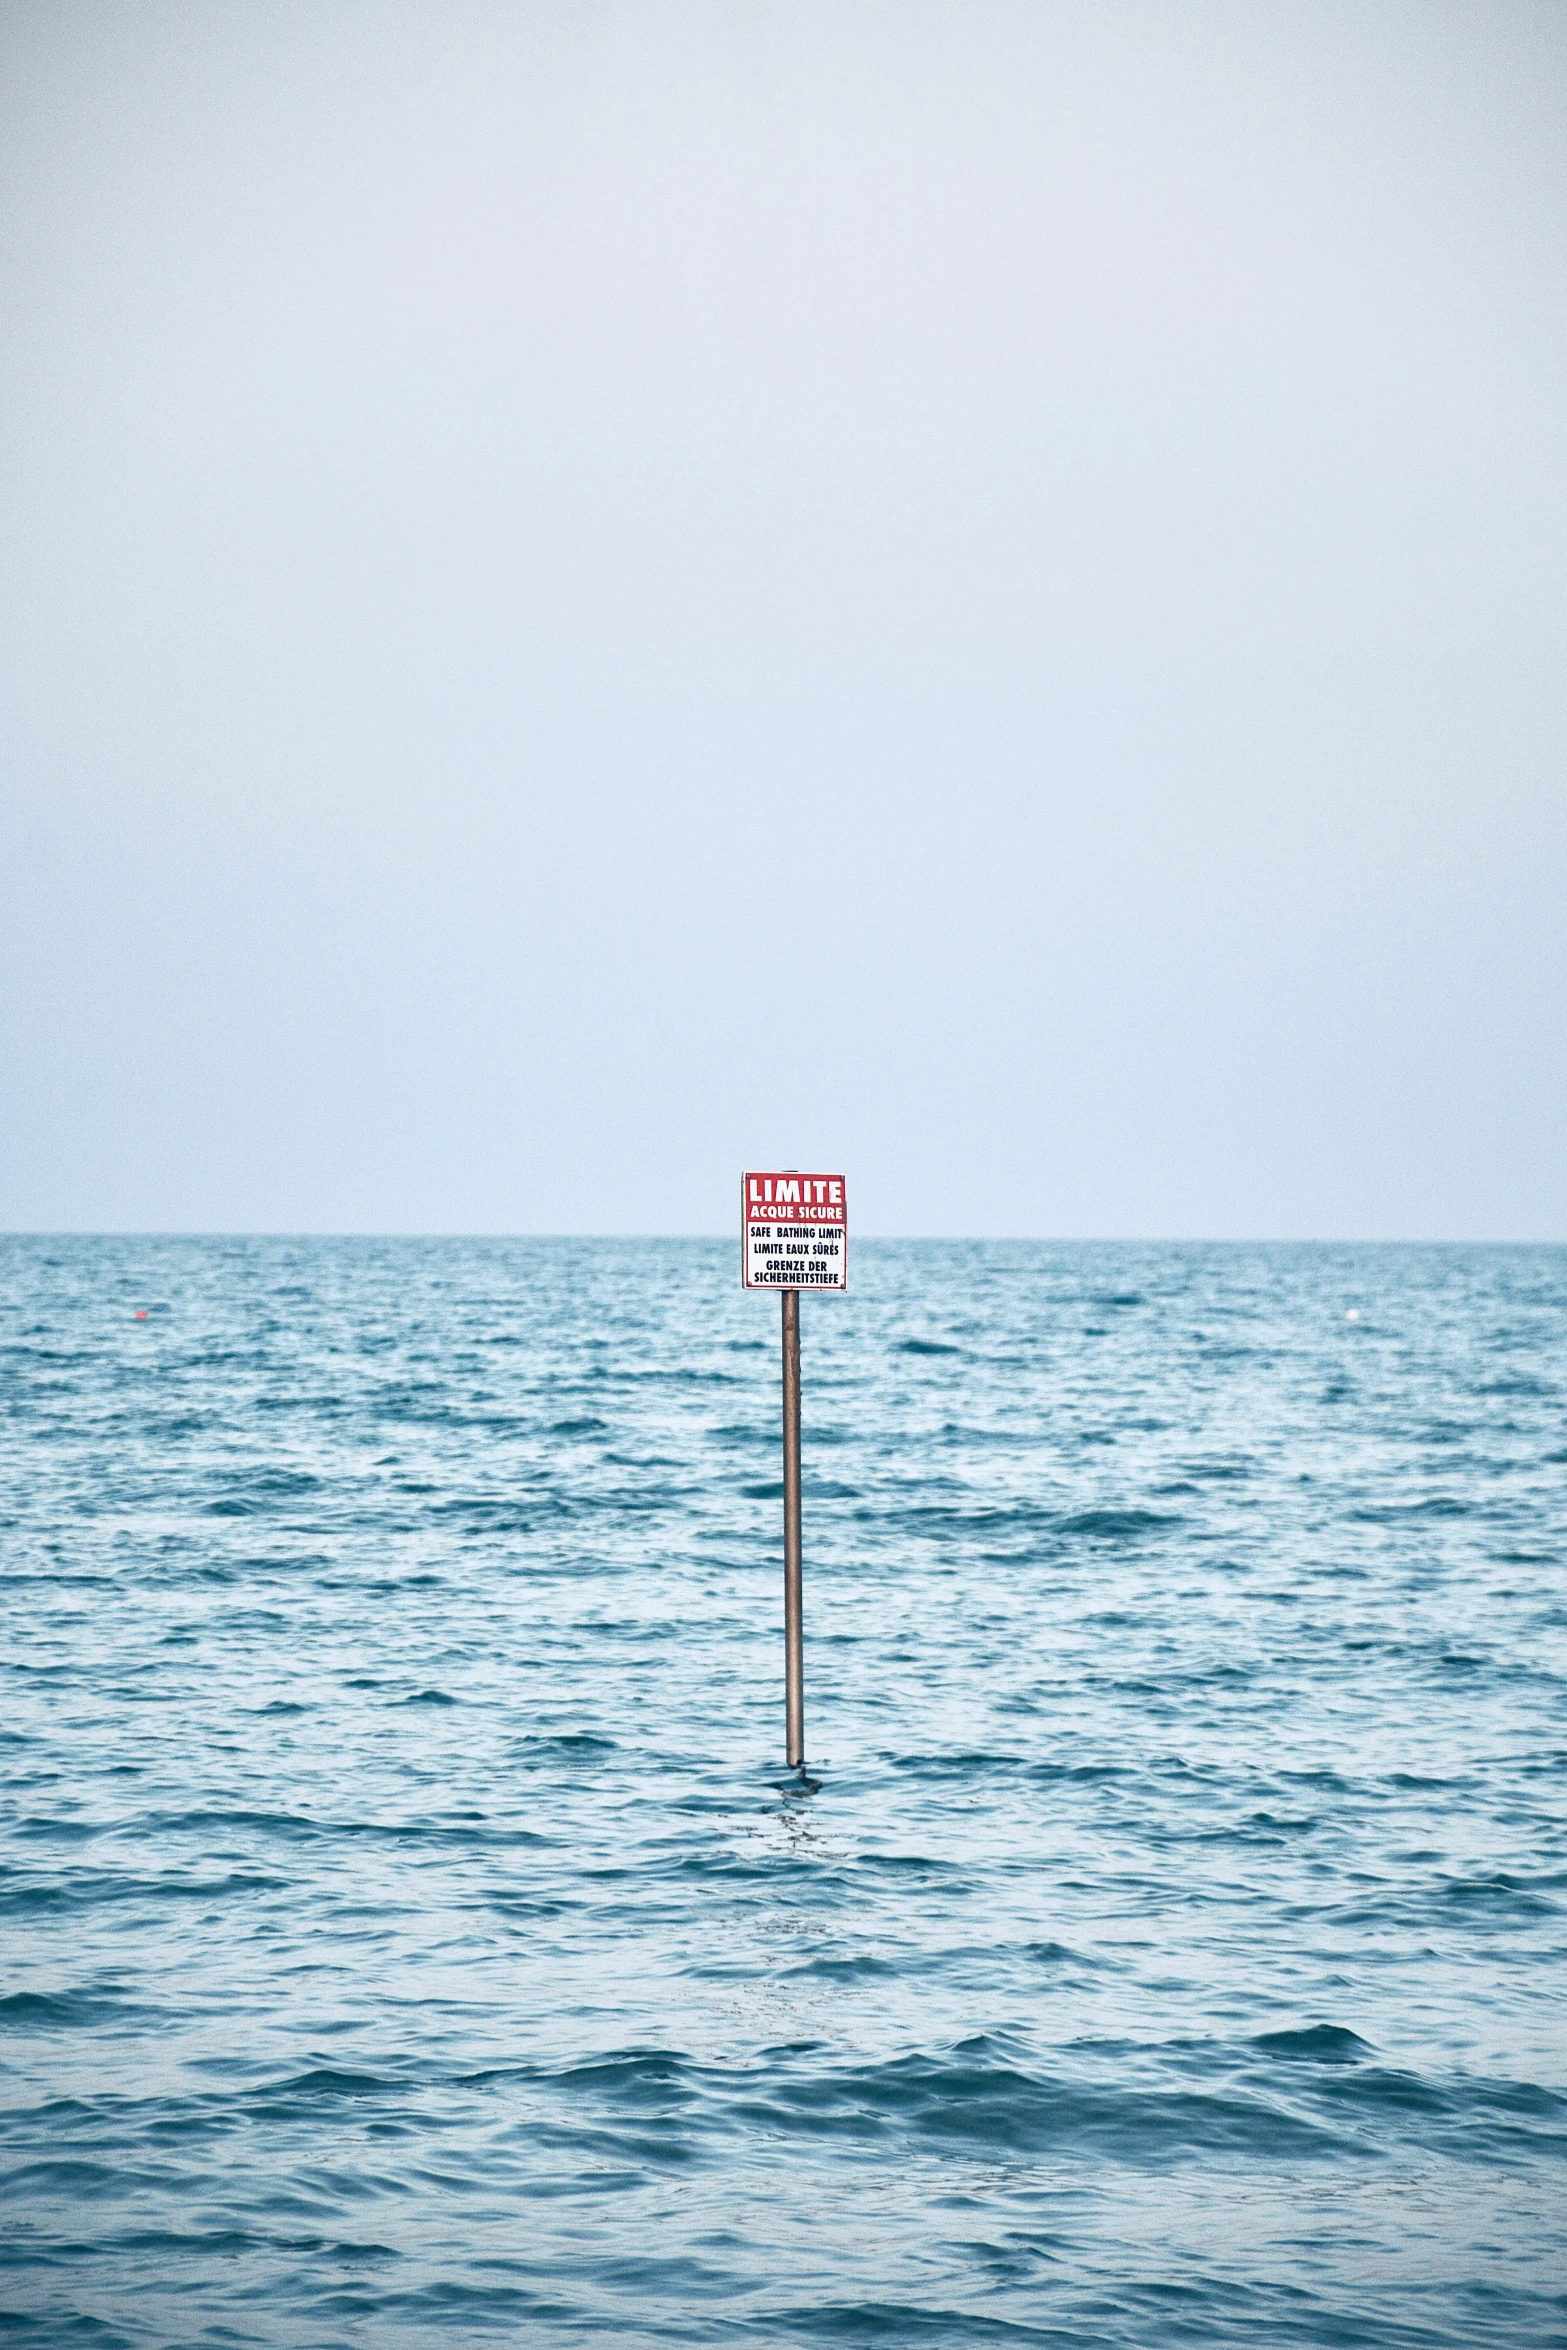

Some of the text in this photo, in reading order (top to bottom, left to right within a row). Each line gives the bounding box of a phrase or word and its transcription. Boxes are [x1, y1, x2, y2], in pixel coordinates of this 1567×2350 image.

[750, 1179, 842, 1203] LIMITE
[750, 1205, 843, 1219] ACQUE SICURE
[751, 1227, 843, 1239] SAFE BATHING LIMIT
[754, 1241, 839, 1255] LIMITE EAUX SÛRES
[766, 1260, 827, 1272] GRENZE DER
[754, 1272, 839, 1284] SICHERHEITSTIEFE
